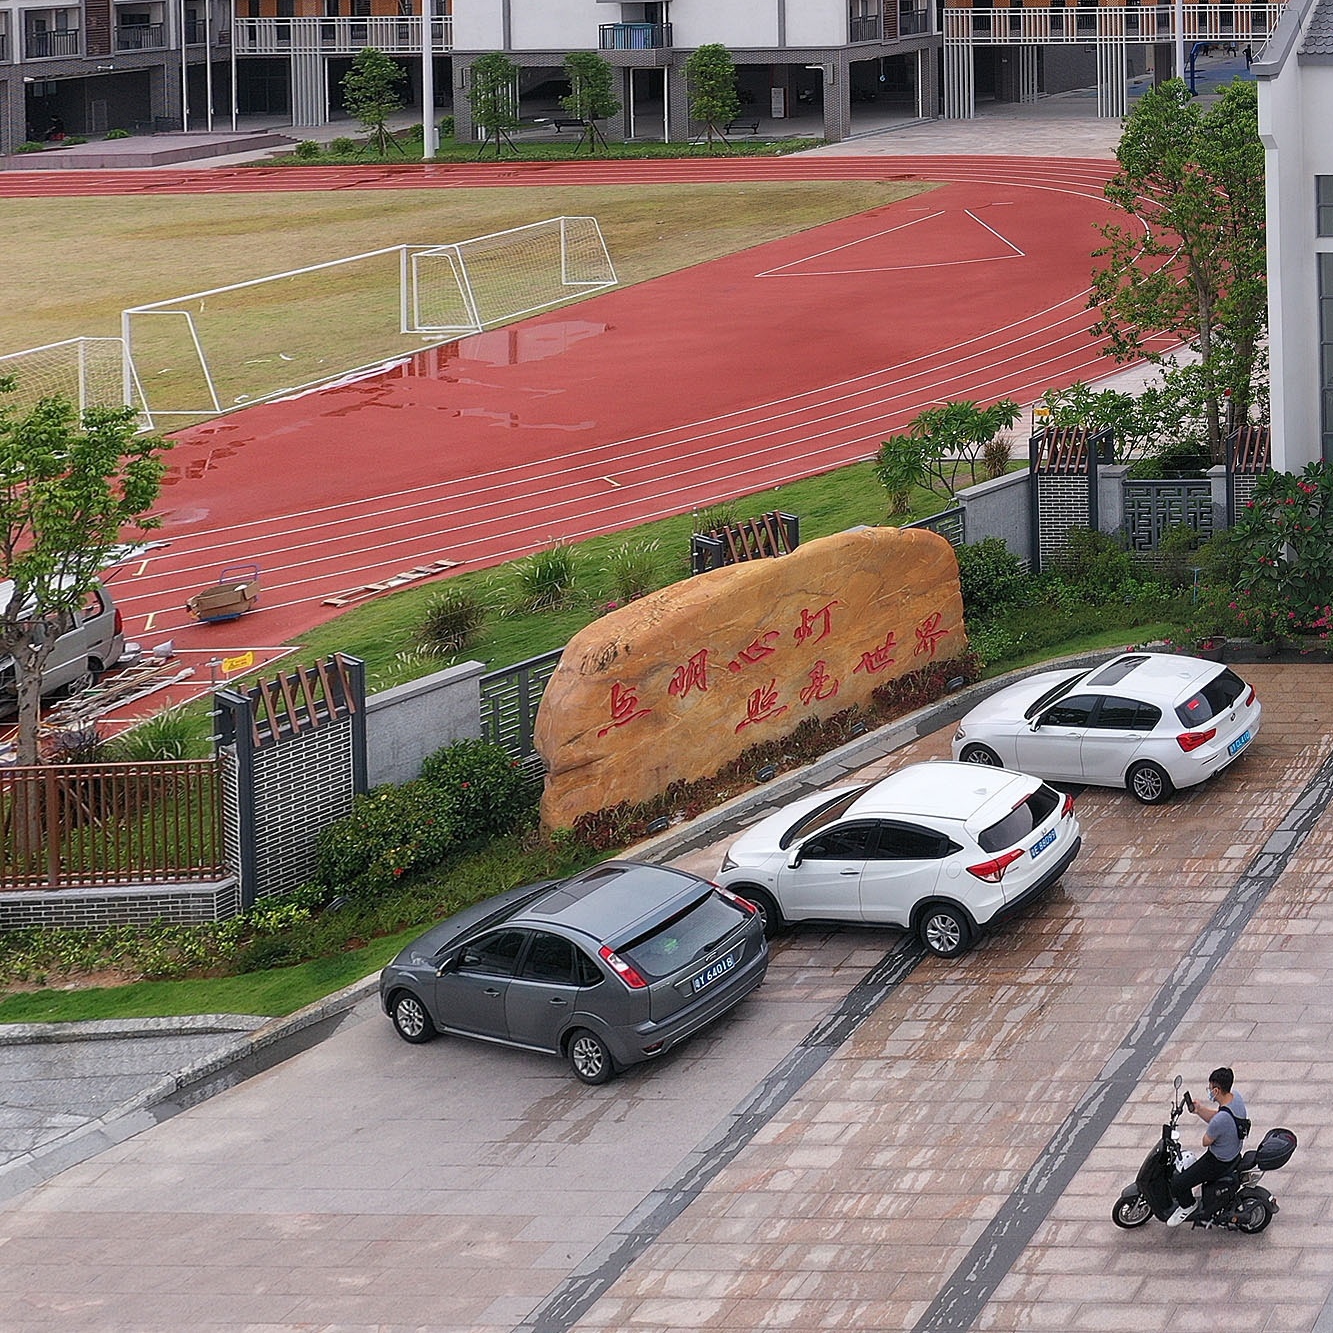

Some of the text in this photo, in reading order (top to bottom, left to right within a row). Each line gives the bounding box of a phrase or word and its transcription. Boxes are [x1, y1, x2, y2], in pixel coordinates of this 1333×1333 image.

[597, 600, 839, 737] 点明心灯
[735, 612, 950, 734] 照亮世界
